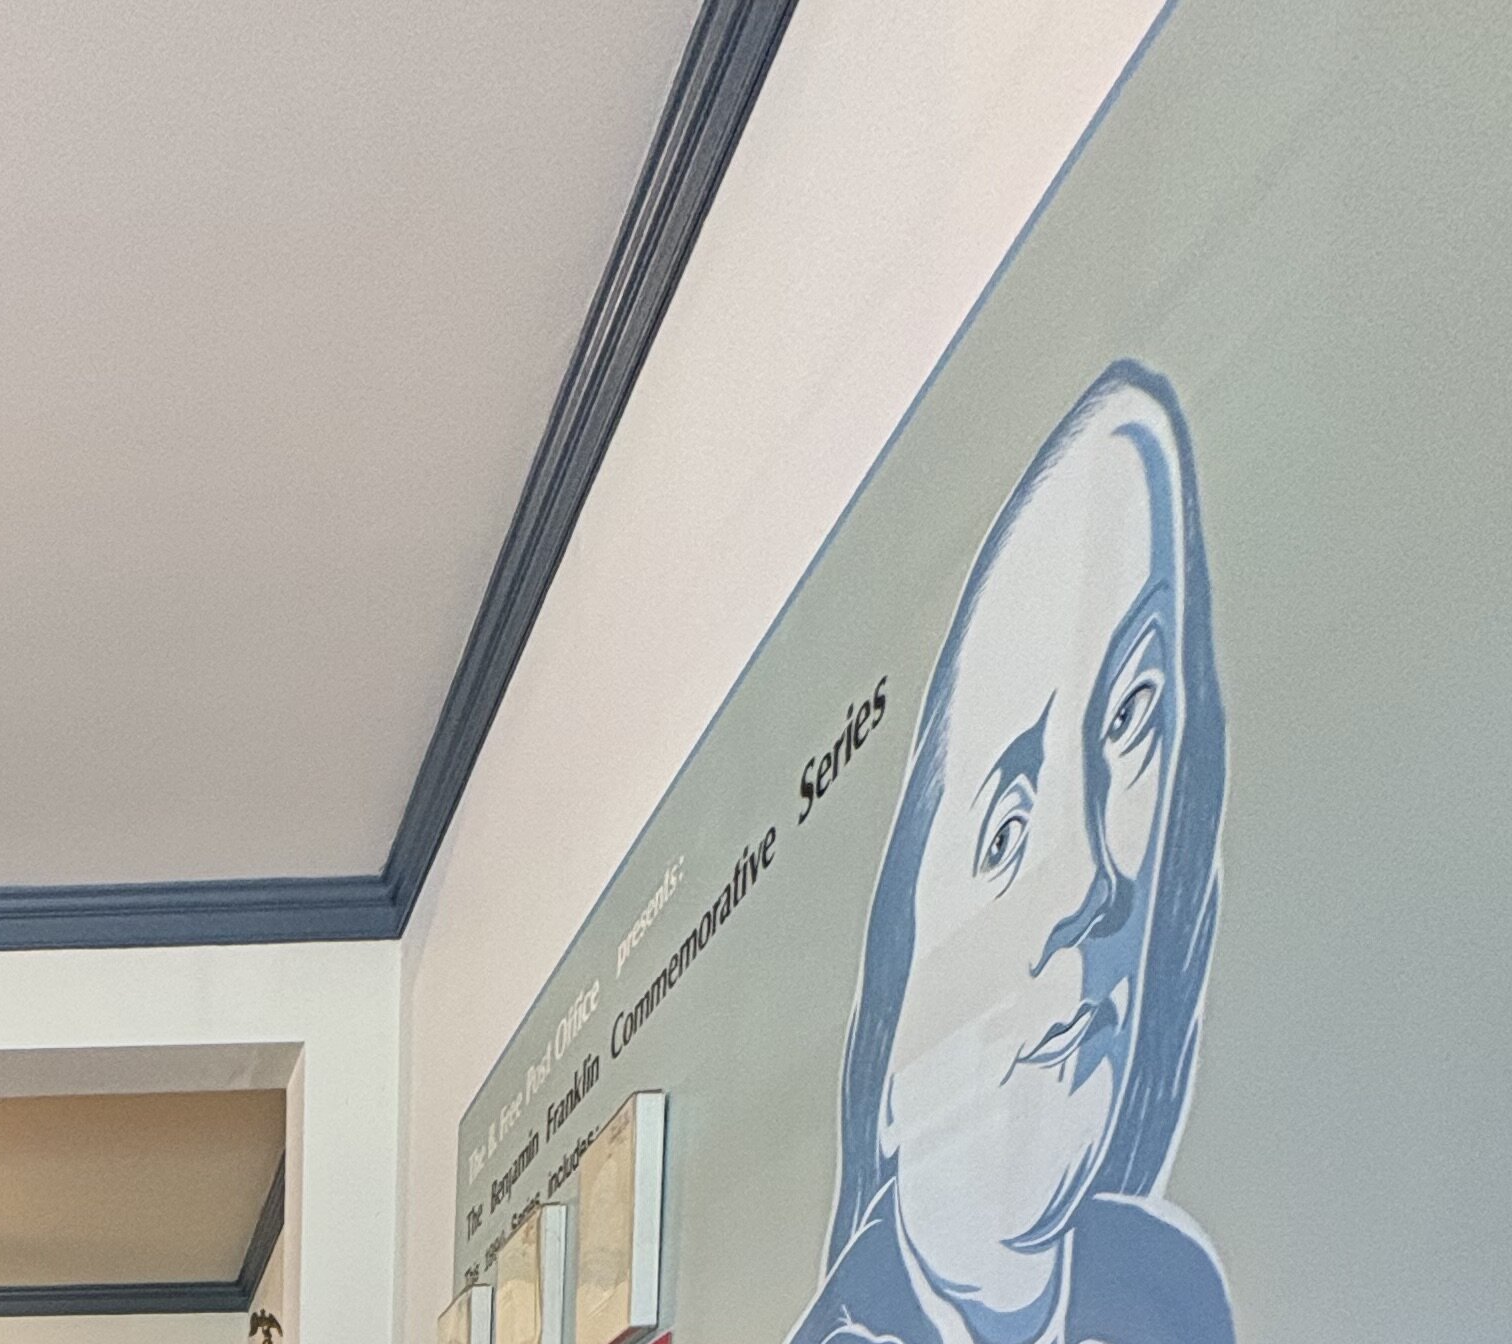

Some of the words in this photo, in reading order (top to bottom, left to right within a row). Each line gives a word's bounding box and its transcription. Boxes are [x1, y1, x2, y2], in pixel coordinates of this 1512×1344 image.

[466, 1201, 483, 1242] The
[490, 1128, 540, 1216] Benjamin
[545, 1053, 601, 1144] Franklin
[610, 826, 778, 1060] Commemorative
[798, 674, 889, 826] Series
[525, 1041, 553, 1105] Post
[554, 978, 601, 1061] Office
[615, 855, 686, 979] presents:
